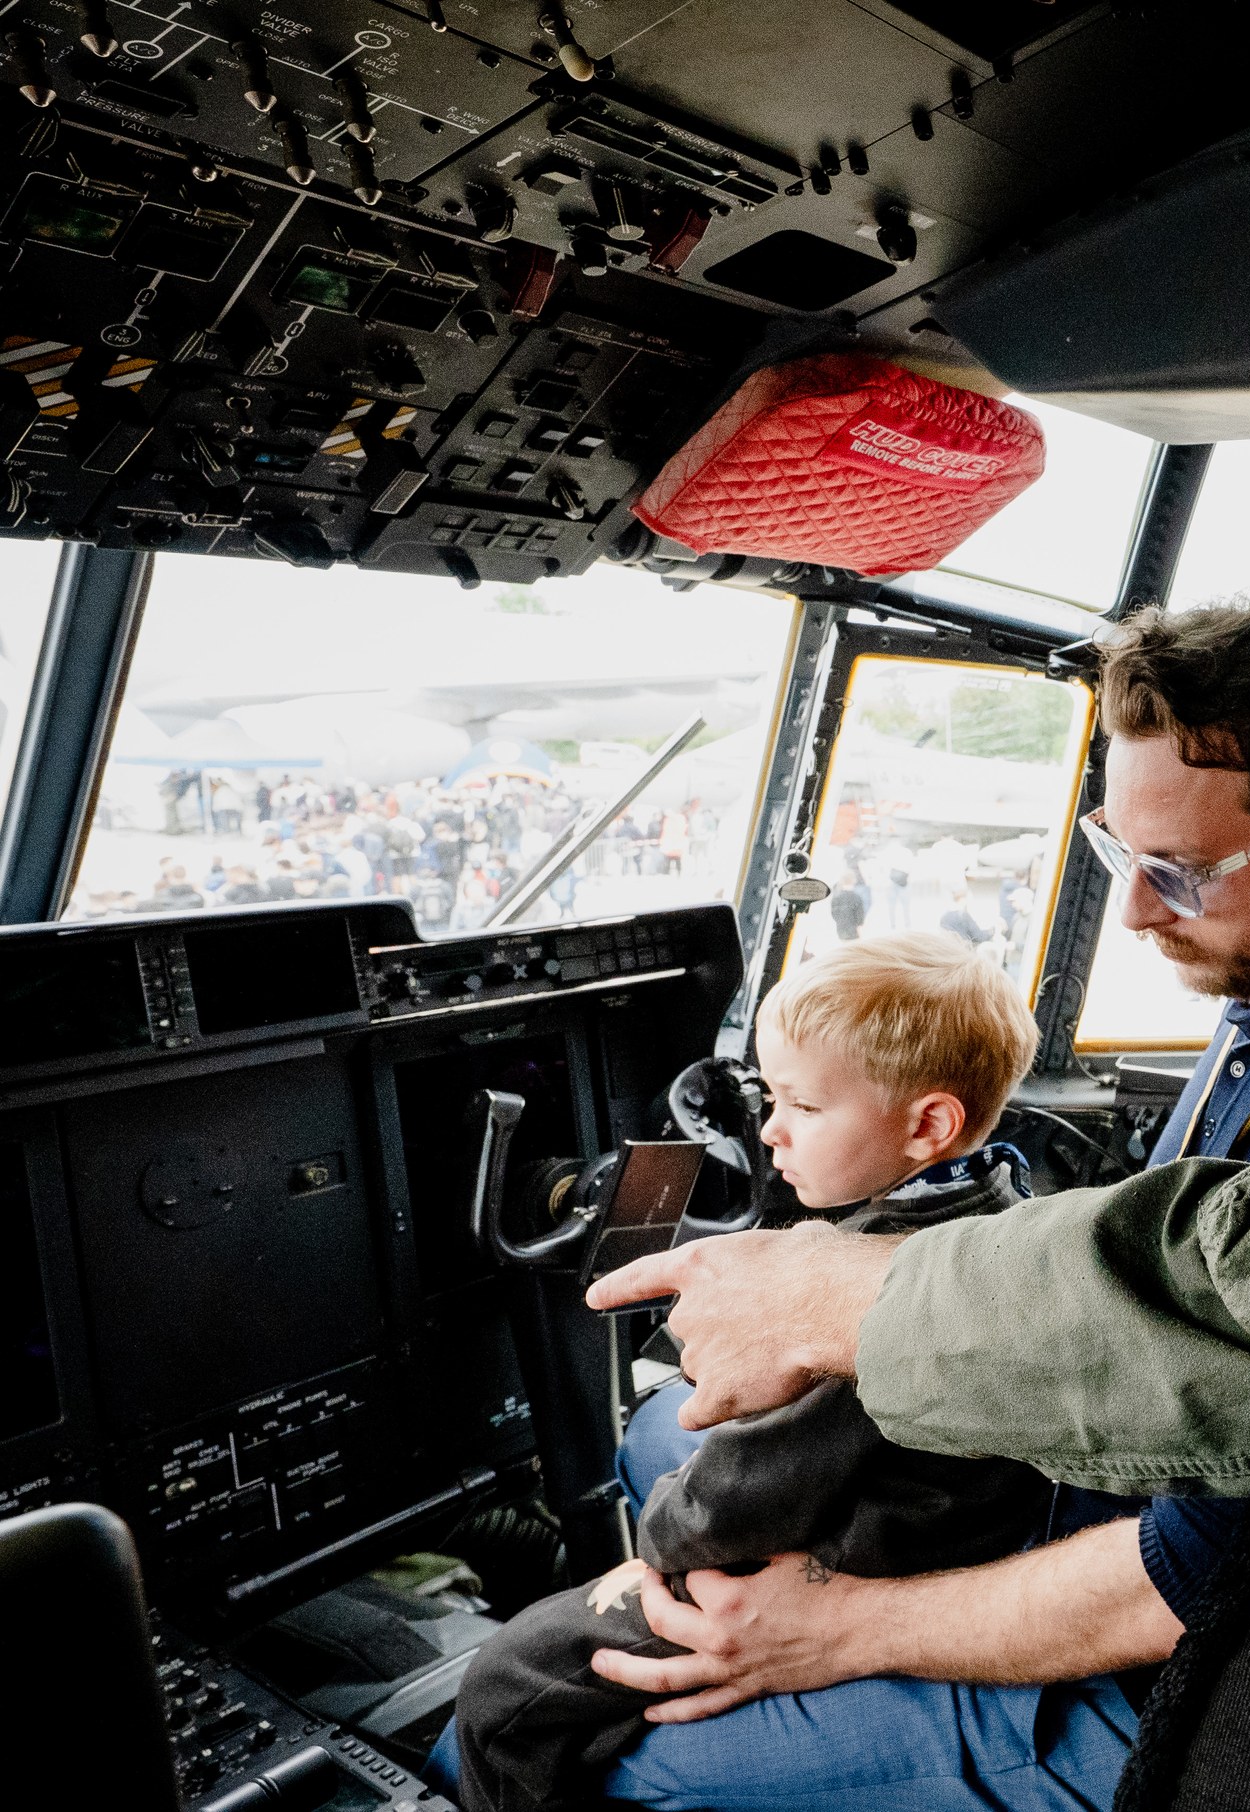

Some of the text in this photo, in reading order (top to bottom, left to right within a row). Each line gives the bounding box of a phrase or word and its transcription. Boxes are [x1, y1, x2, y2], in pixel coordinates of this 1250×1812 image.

[458, 3, 480, 16] UTIL
[23, 18, 63, 35] CLOSE
[260, 10, 312, 34] DIVIDER
[260, 18, 300, 38] VALVE
[367, 19, 410, 39] CARGO
[362, 57, 400, 75] VALVE
[76, 95, 152, 122] PRESSURE
[120, 119, 162, 139] VALVE
[653, 120, 746, 161] PRESSURIZATION
[76, 188, 104, 201] AUX
[183, 216, 213, 230] MAIN
[107, 333, 131, 345] ENG
[849, 418, 922, 455] HUD
[850, 438, 901, 465] REMOVE
[897, 455, 946, 477] BEFORE
[151, 472, 176, 483] ELT
